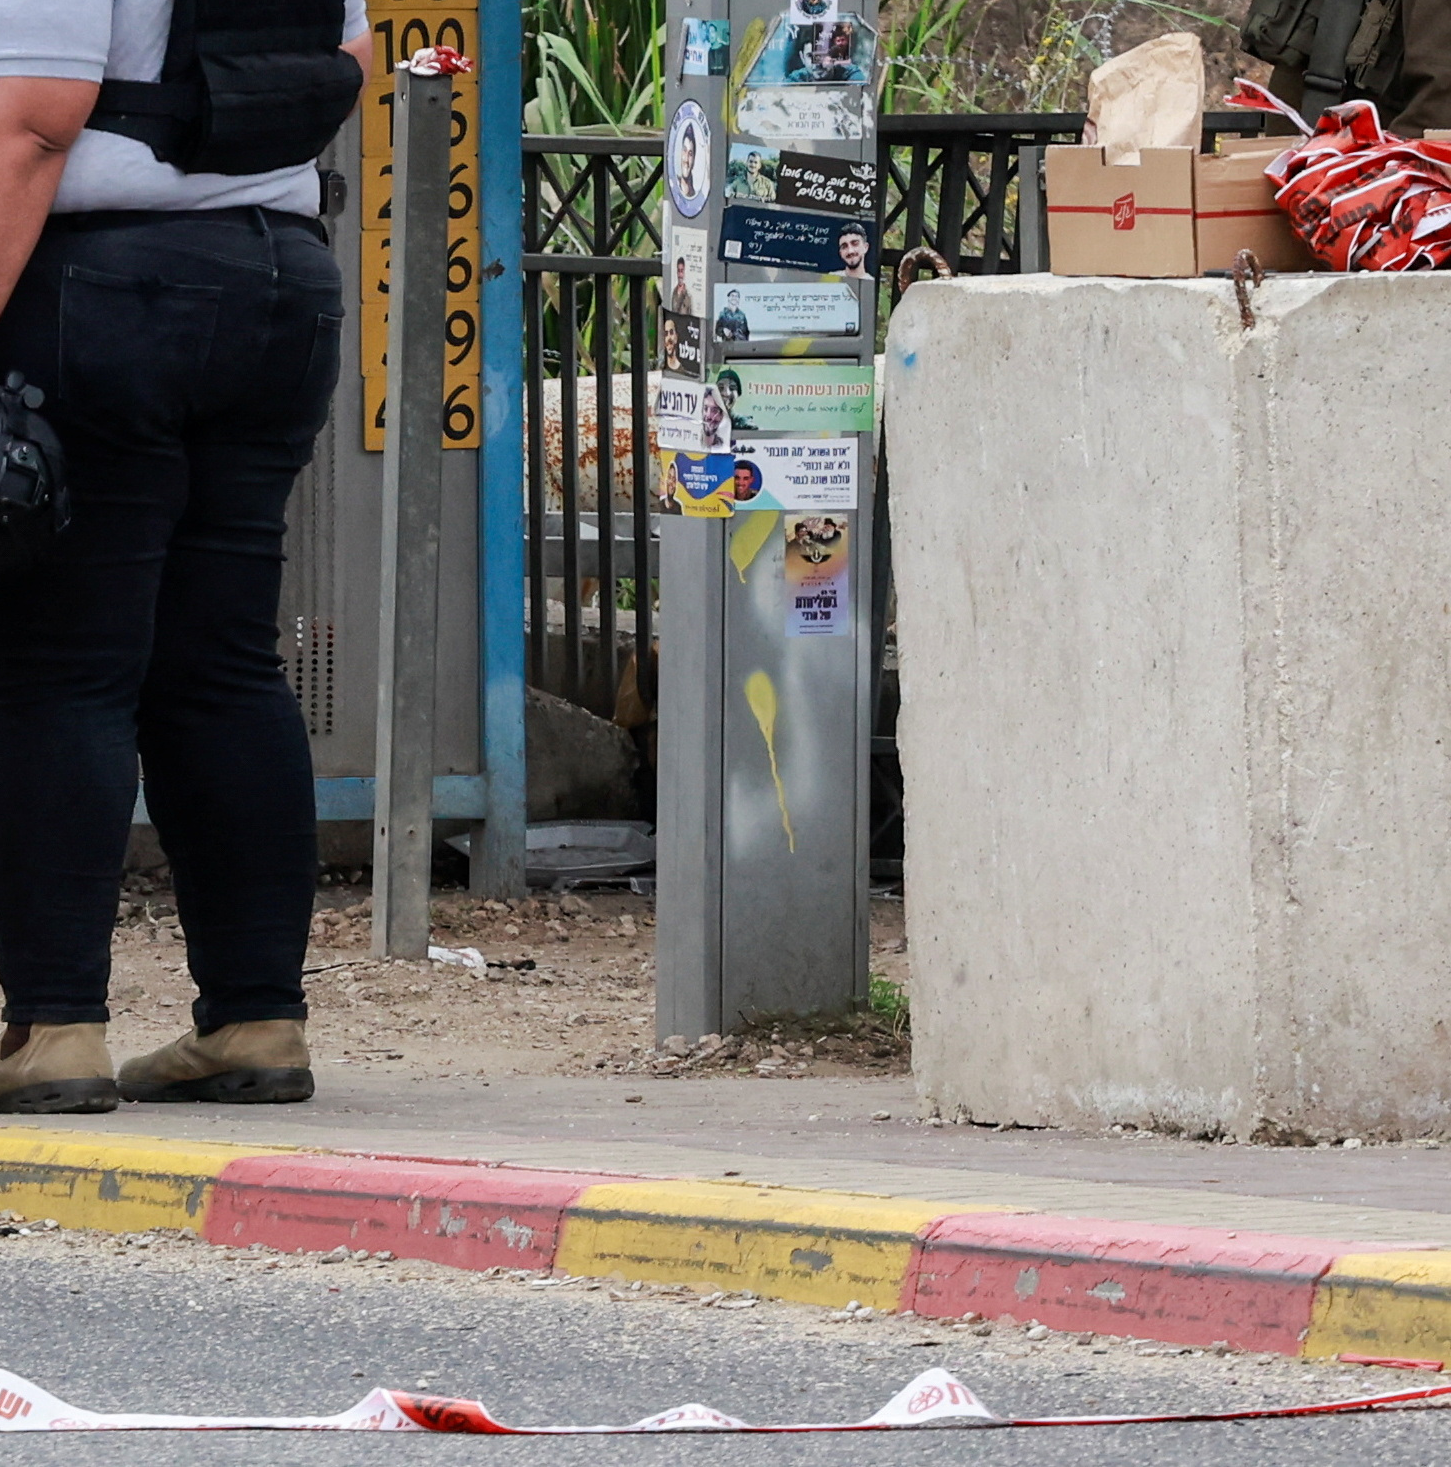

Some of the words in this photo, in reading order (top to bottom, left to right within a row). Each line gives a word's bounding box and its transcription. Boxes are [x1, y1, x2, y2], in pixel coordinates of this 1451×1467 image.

[749, 383, 784, 395] תמיד!
[787, 384, 834, 395] בשמחה
[837, 382, 870, 397] להיות
[686, 392, 698, 416] עד
[837, 461, 850, 471] ולא
[810, 475, 828, 485] שונה
[830, 474, 850, 484] עולמו
